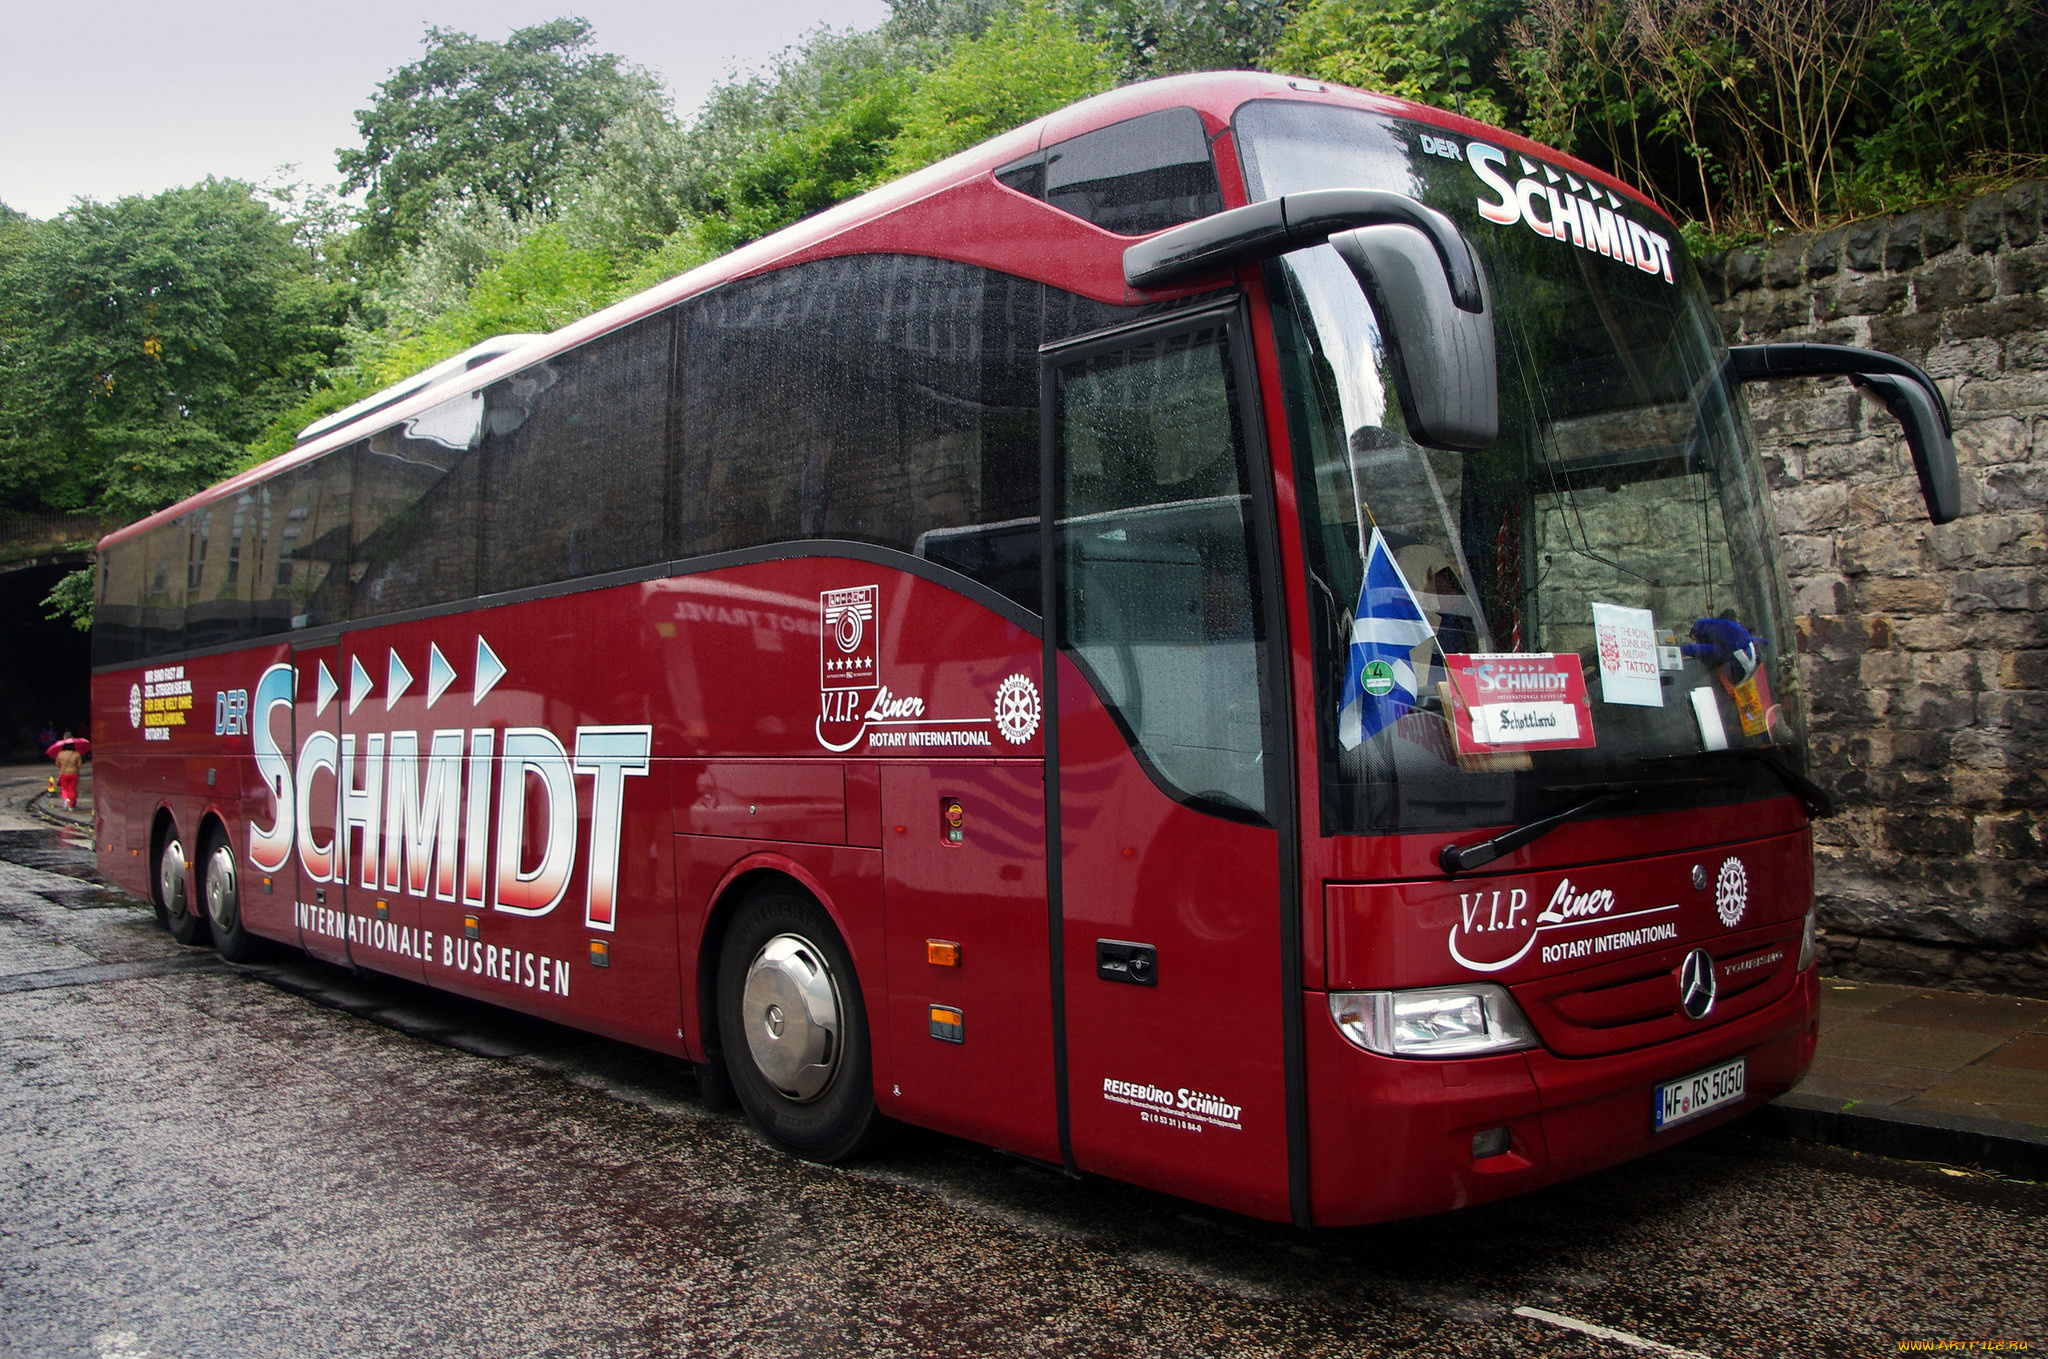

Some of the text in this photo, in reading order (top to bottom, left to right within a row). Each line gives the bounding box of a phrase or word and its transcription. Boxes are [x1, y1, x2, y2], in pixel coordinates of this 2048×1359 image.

[1419, 134, 1674, 285] DER SCHMIDT
[1621, 626, 1650, 639] THE ROYAL
[1621, 638, 1653, 650] EDINBURGH
[1373, 662, 1383, 678] 4
[1622, 649, 1647, 660] MILITARY
[1624, 660, 1656, 674] TATTOO
[1478, 663, 1569, 694] SCHMIDT
[820, 685, 925, 722] V.I.P. Liner
[869, 730, 991, 747] ROTARY INTERNATIONAL
[215, 663, 652, 932] DER SCHMIDT
[1460, 878, 1615, 934] V.I.P. Liner
[295, 901, 570, 996] INTERNATIONALE BUSREISEN
[1541, 922, 1678, 963] ROTARY INTERNATIONAL
[1103, 1077, 1174, 1106] REISEBÜRO
[1176, 1087, 1242, 1121] SCHMIDT
[1692, 1076, 1709, 1108] RS
[1712, 1064, 1742, 1100] 5050
